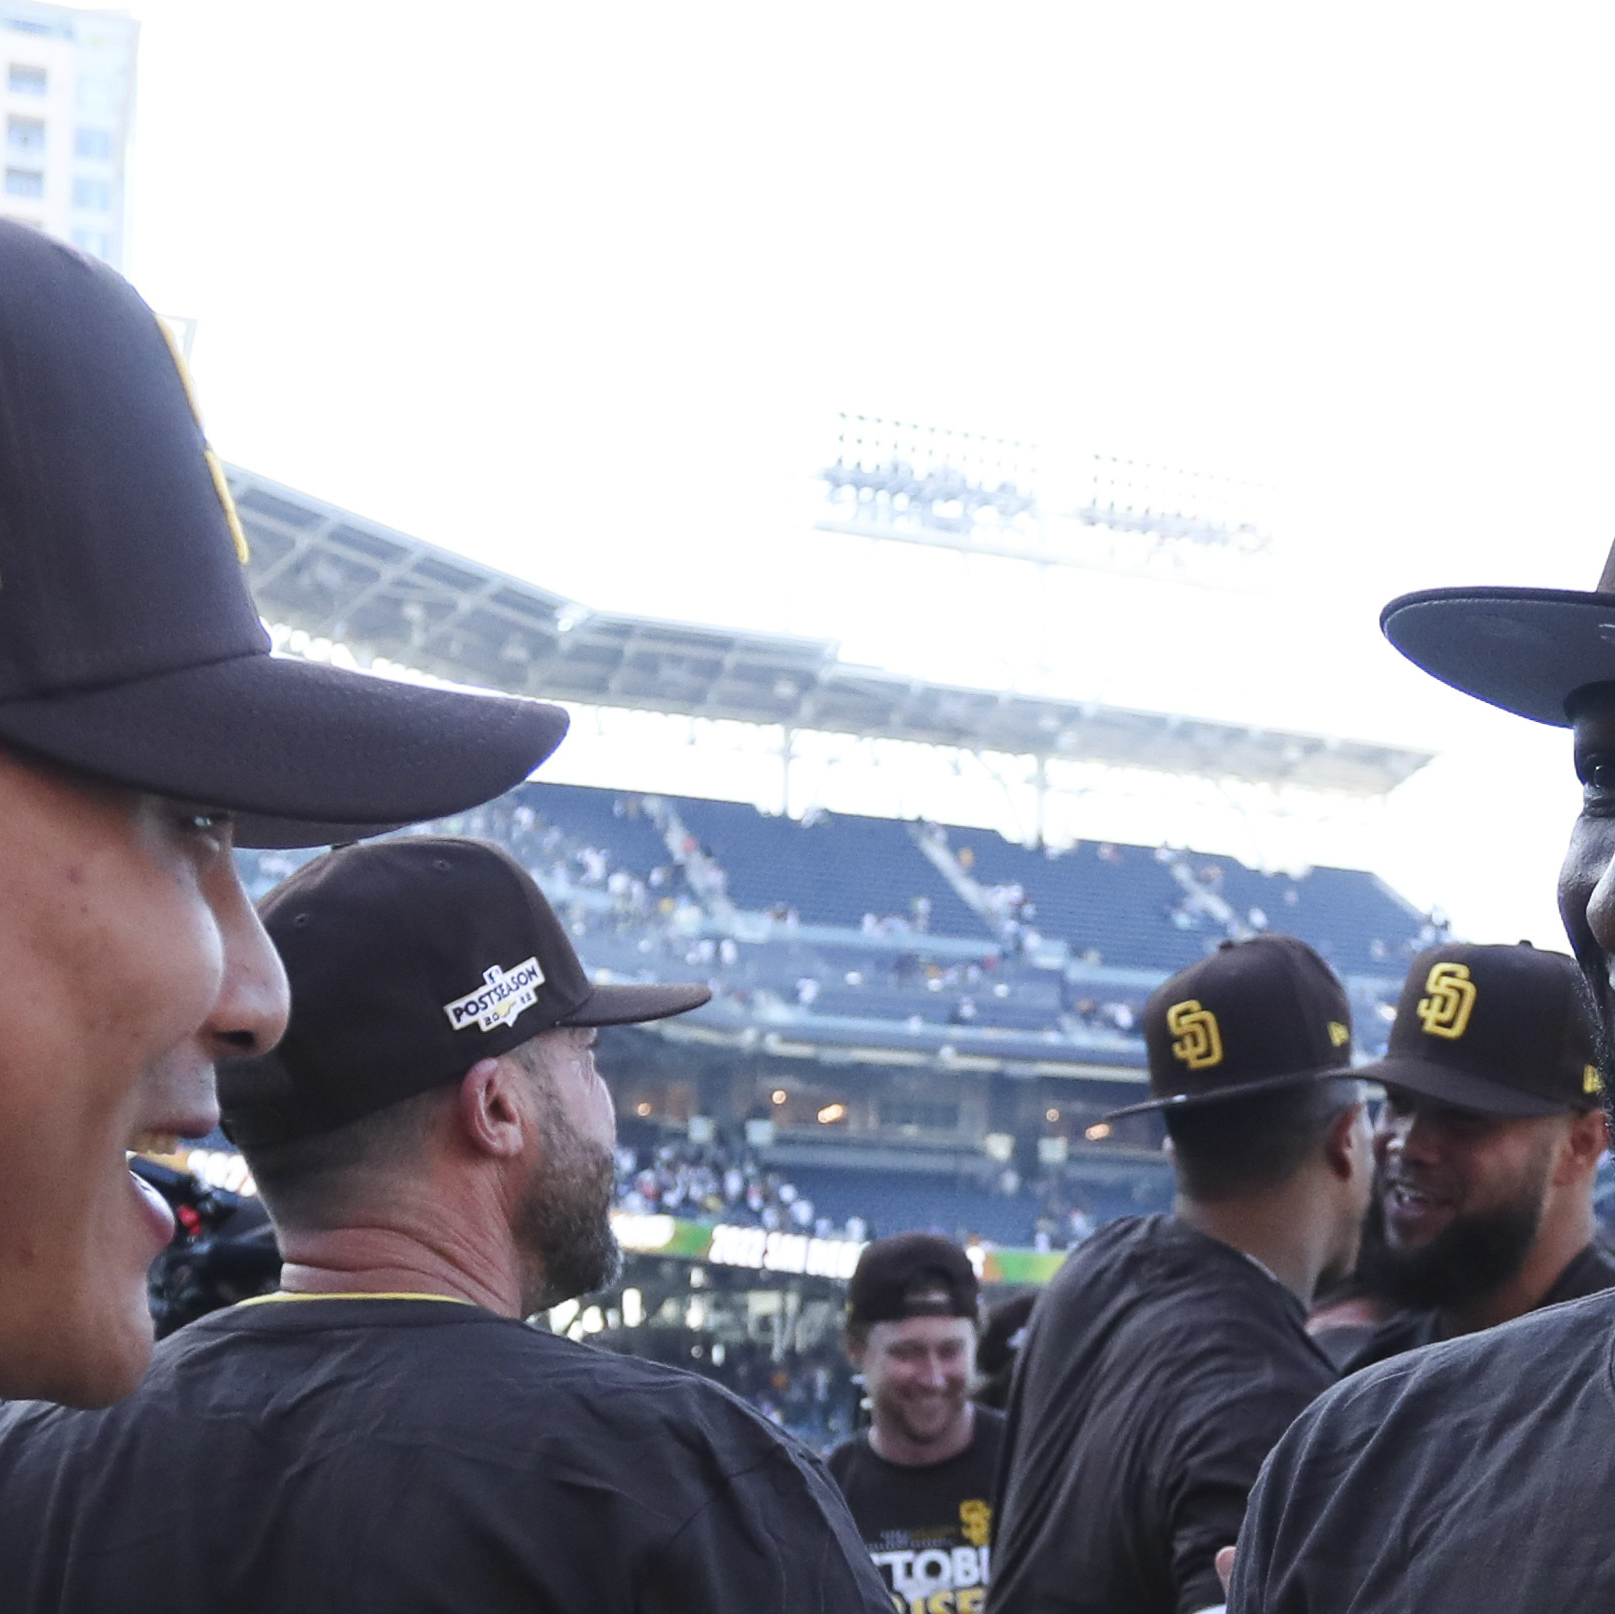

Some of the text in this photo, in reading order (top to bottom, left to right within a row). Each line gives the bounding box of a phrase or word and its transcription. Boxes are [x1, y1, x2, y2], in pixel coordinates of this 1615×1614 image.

[452, 965, 539, 1023] POSTSEASON
[1417, 962, 1477, 1040] SD
[1167, 999, 1224, 1069] SD
